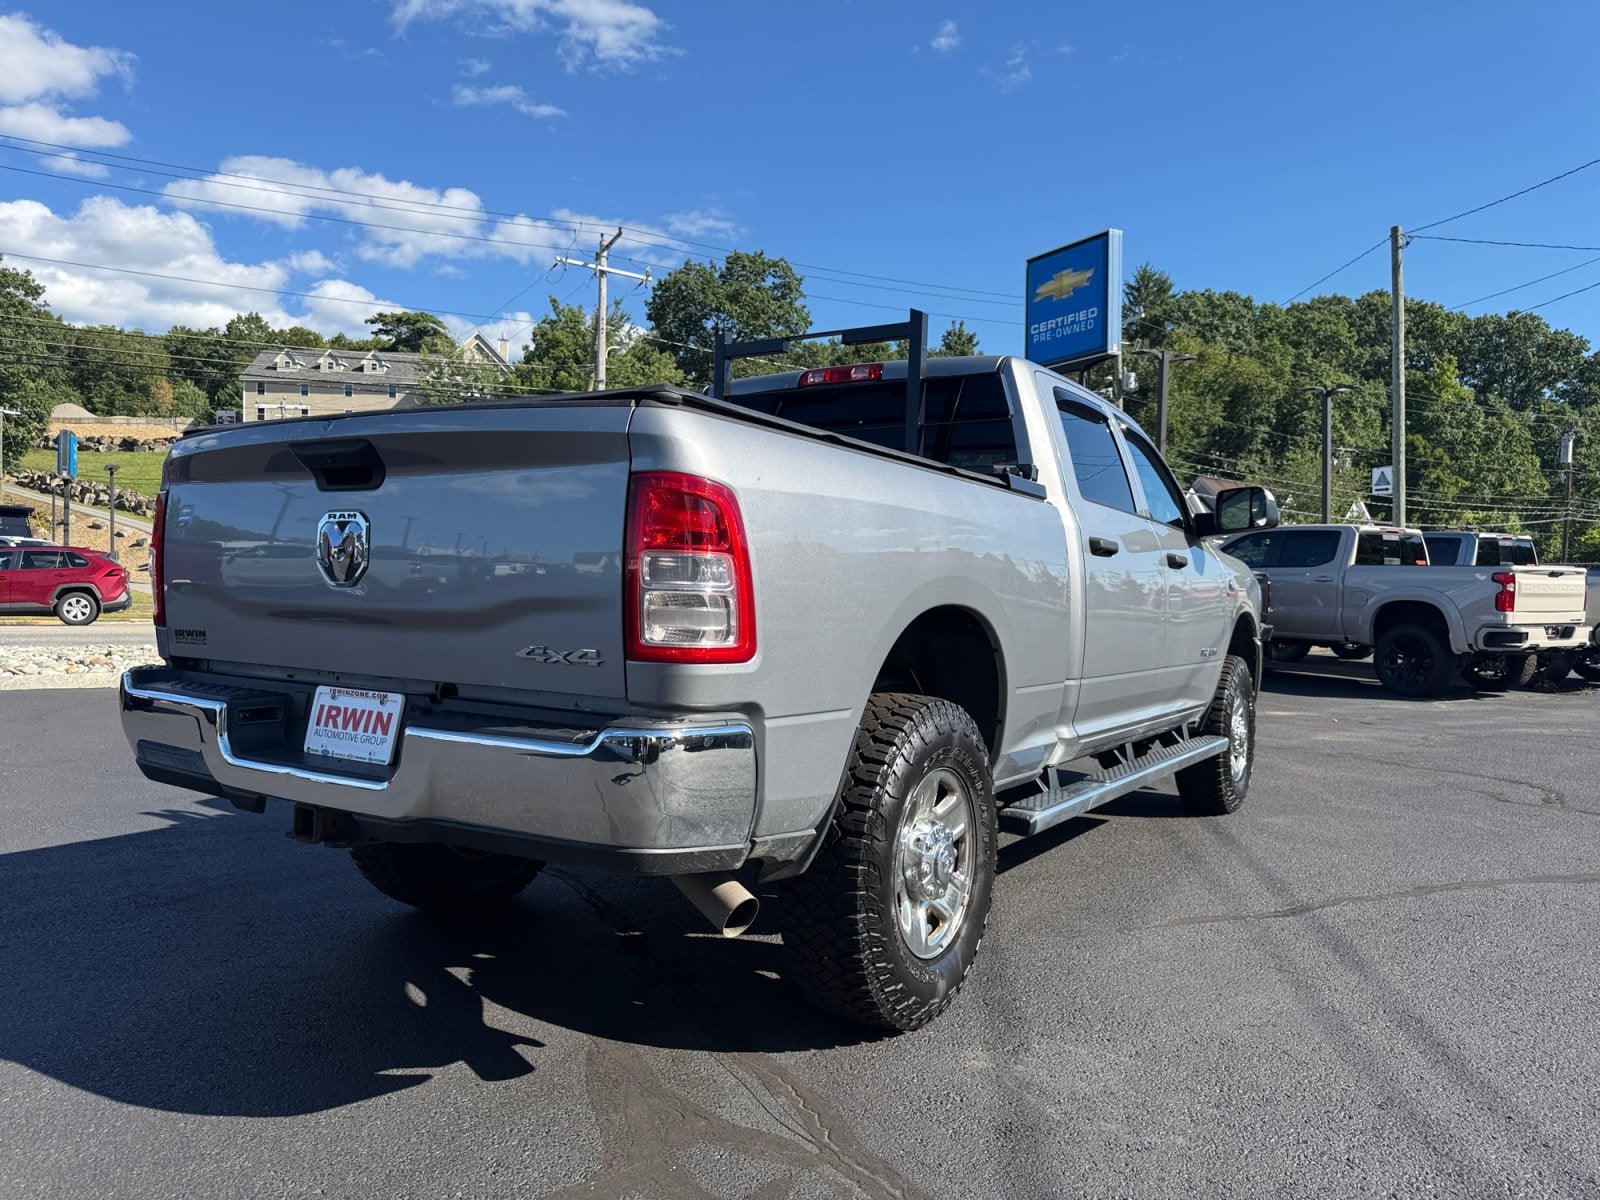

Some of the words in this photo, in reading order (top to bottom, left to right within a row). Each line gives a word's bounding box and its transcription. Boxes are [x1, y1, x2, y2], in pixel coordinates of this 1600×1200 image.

[1030, 307, 1098, 335] CERTIFIED
[1033, 319, 1094, 344] PRE-OWNED
[174, 629, 207, 637] IRWIN
[329, 688, 388, 700] IRWINZONE.COM
[315, 704, 394, 737] IRWIN
[313, 728, 359, 743] AUTOMOTIVE
[360, 734, 387, 747] GROUP
